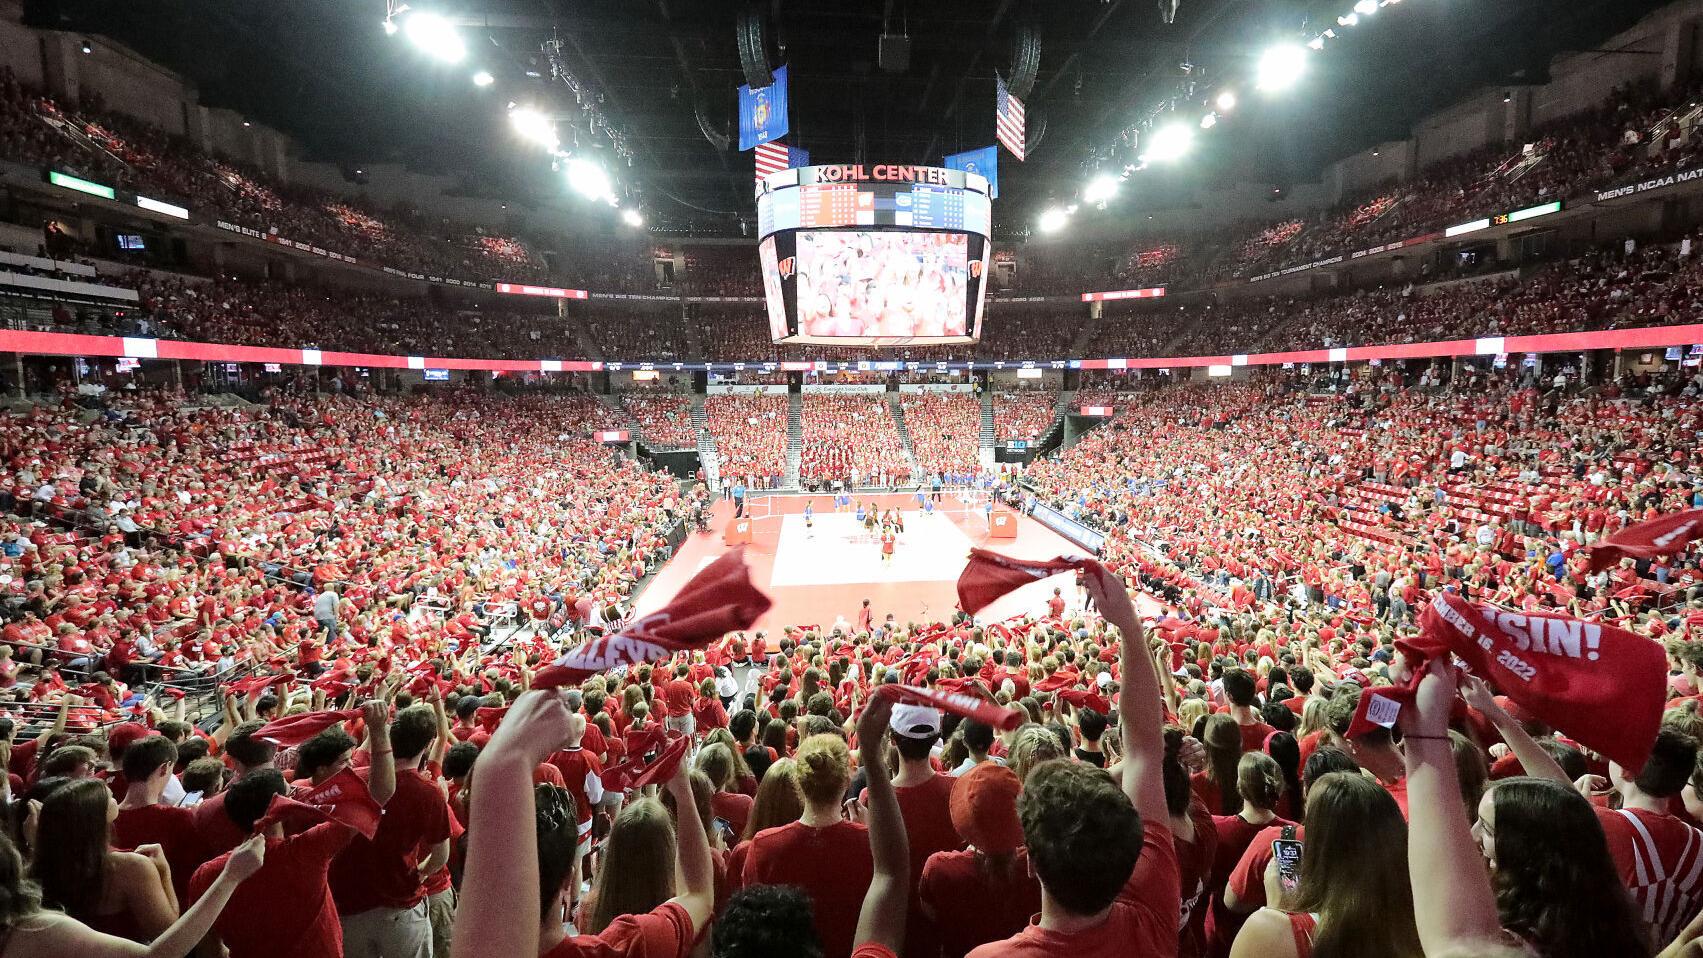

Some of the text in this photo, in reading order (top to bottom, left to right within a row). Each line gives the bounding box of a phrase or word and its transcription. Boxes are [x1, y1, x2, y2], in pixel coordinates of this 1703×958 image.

[815, 165, 948, 185] KOHL CENTER
[1597, 186, 1634, 201] MEN'S
[1637, 176, 1674, 192] NCAA
[217, 220, 241, 233] MEN'S
[241, 227, 260, 238] ELITE
[1496, 650, 1537, 682] 2022
